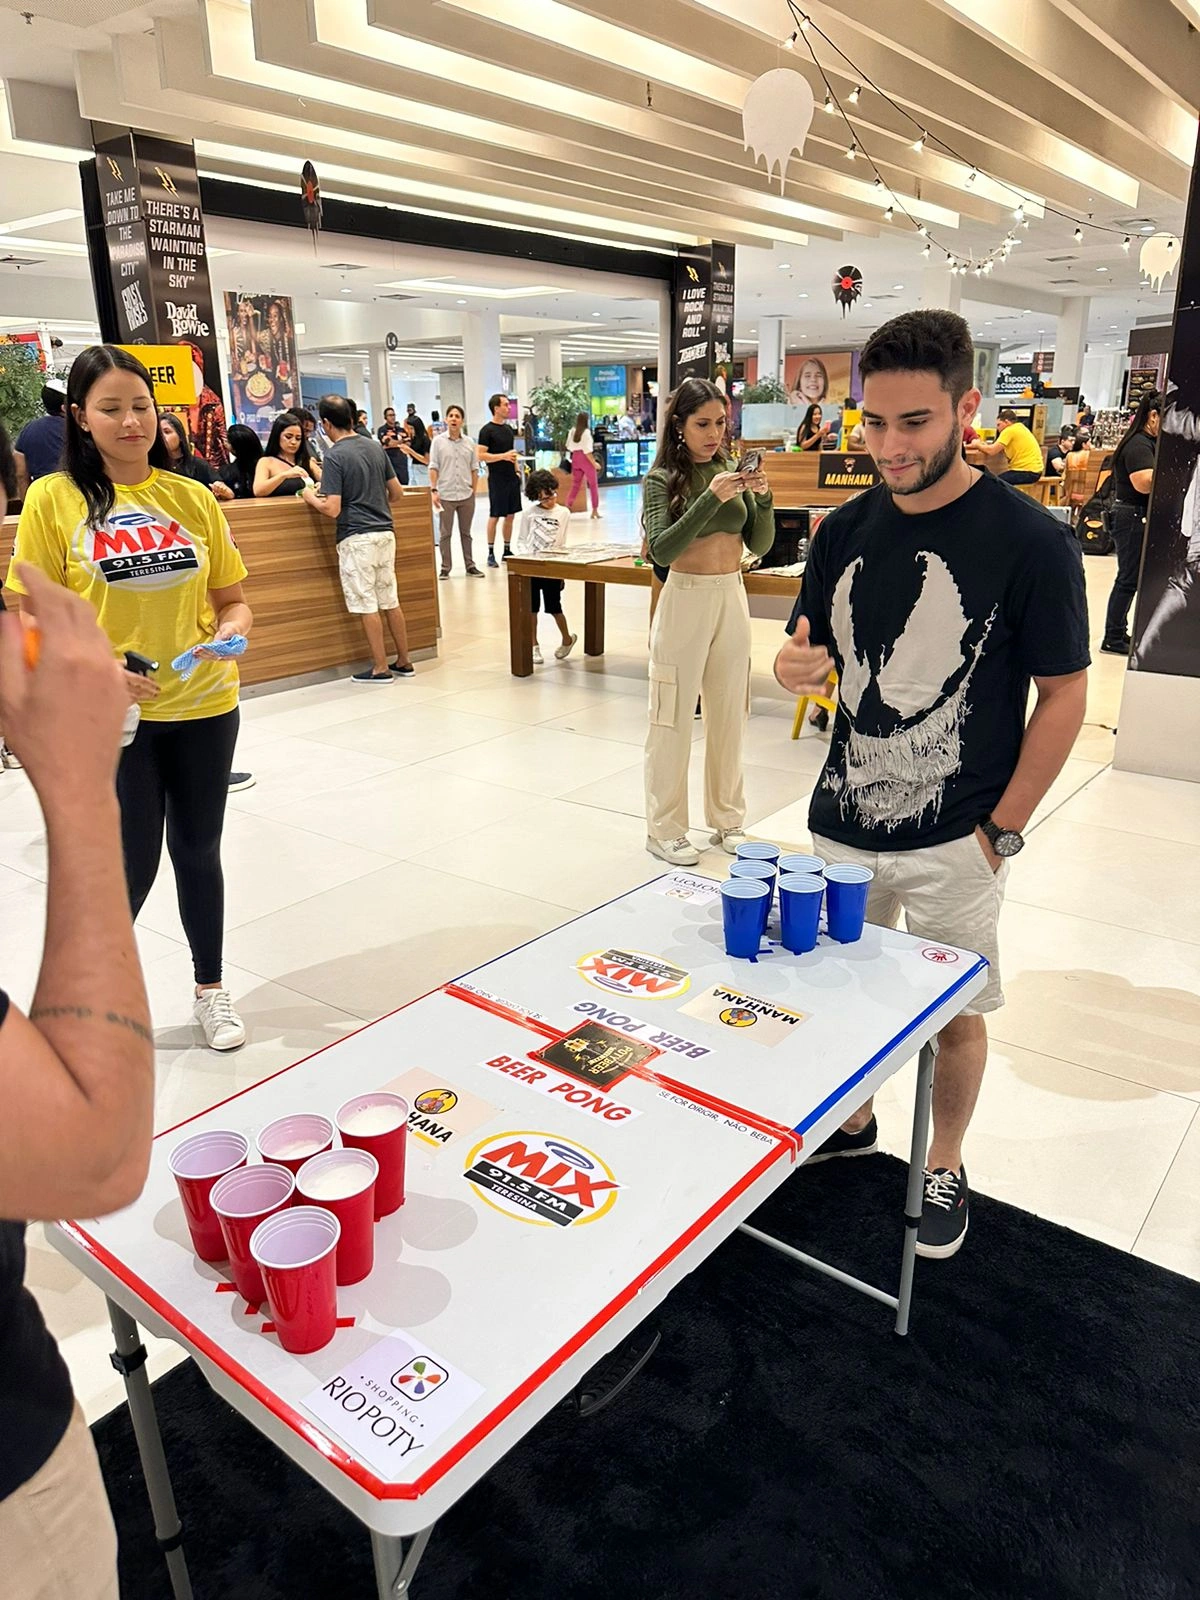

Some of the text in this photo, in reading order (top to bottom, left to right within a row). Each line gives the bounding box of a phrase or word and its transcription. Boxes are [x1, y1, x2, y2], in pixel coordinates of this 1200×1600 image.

[106, 187, 136, 207] TAKE ME
[130, 205, 139, 220] TO
[146, 200, 200, 221] THERE'S A
[119, 226, 132, 240] THE
[149, 219, 201, 238] STARMAN
[151, 237, 204, 256] WAINTING
[163, 256, 197, 272] IN THE
[682, 287, 707, 300] I LOVE
[165, 301, 199, 320] David
[684, 301, 705, 313] ROCK
[172, 319, 210, 337] Bowie
[685, 314, 702, 325] AND
[149, 365, 176, 385] EER
[825, 473, 873, 486] MANHANA
[93, 520, 192, 561] MIX
[112, 550, 185, 569] 91.5 FM
[129, 564, 172, 577] TERESINA
[577, 957, 680, 993] MIX
[713, 988, 800, 1025] MANHANA
[573, 1002, 647, 1033] PONG
[648, 1031, 711, 1059] BEER
[485, 1055, 547, 1085] BEER
[548, 1082, 632, 1121] PONG
[408, 1111, 453, 1143] HANA
[658, 1090, 671, 1099] SE
[670, 1095, 689, 1107] FOR
[723, 1117, 748, 1133] NÃO
[750, 1130, 773, 1145] BEBA
[480, 1140, 621, 1208] MIX
[489, 1168, 568, 1212] 91.5 FM
[490, 1184, 538, 1211] TERESINA
[365, 1379, 419, 1424] SHOPPING
